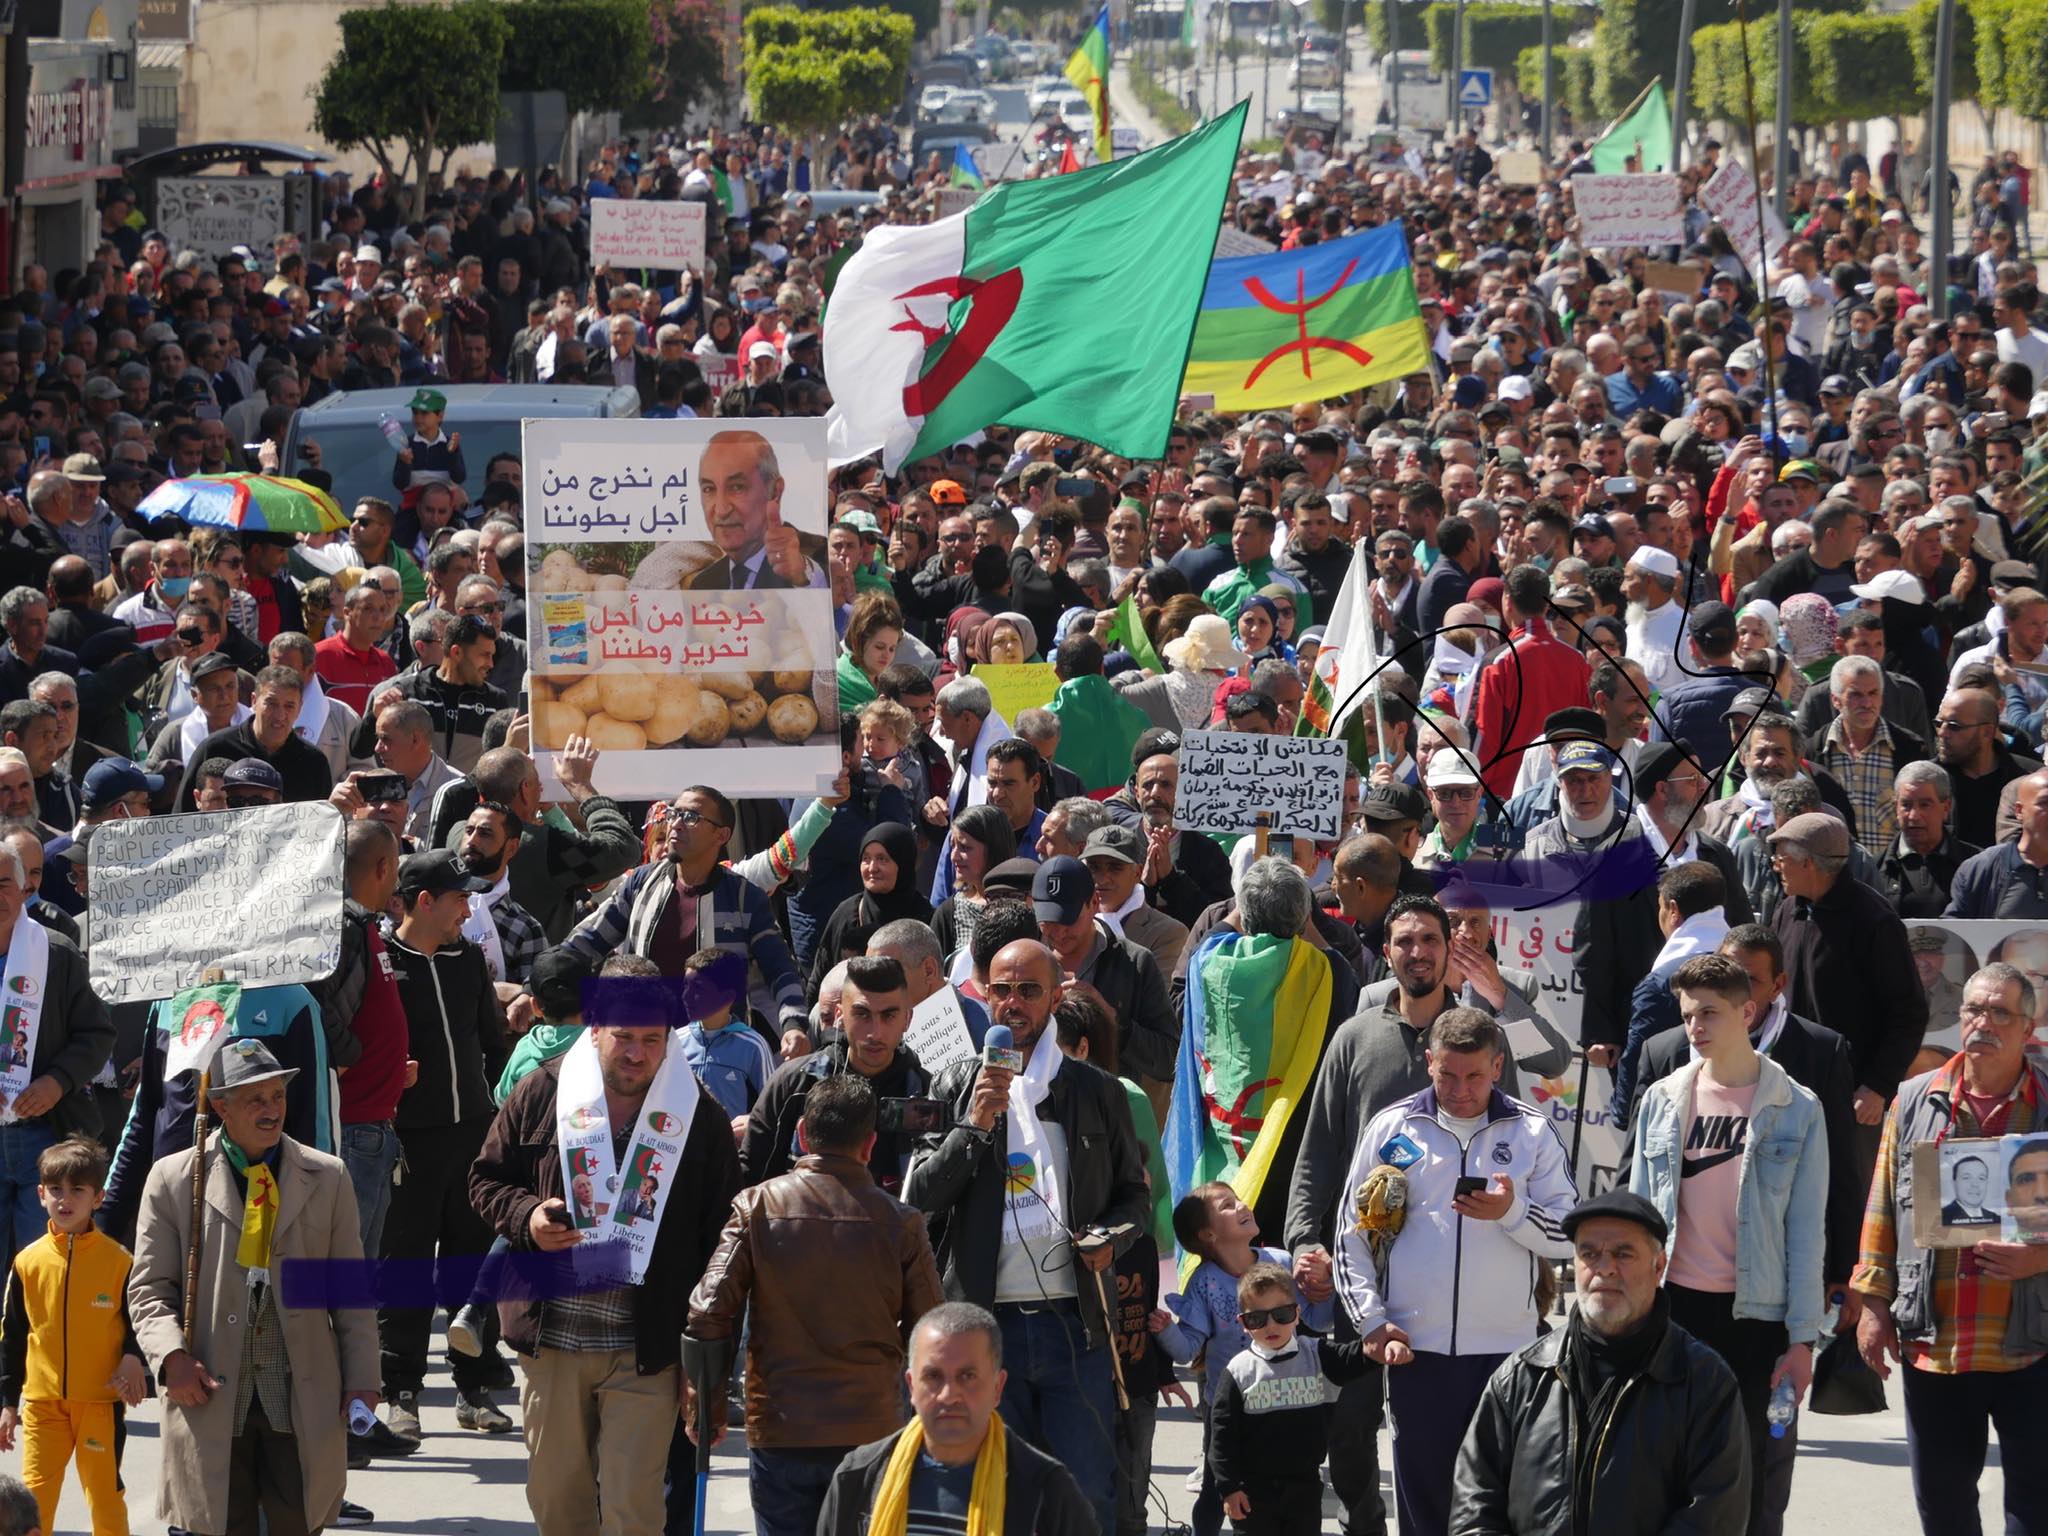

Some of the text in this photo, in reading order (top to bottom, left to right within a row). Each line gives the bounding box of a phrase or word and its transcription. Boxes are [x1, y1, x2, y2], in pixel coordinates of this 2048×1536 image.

[542, 466, 688, 501] لم نخرج من
[543, 493, 688, 534] أجل بطوننا
[589, 594, 638, 635] أجل
[647, 604, 684, 631] من
[690, 602, 765, 632] خرجنا
[601, 635, 749, 666] تحرير وطننا
[1312, 765, 1339, 782] مع
[193, 817, 214, 833] UN
[286, 806, 320, 823] AUX
[1207, 812, 1227, 827] 60
[1320, 815, 1337, 837] لا
[97, 839, 173, 862] PEUPLES
[154, 862, 165, 876] A
[171, 857, 187, 876] LA
[195, 848, 260, 874] MAISON
[90, 881, 135, 902] SANS
[143, 873, 206, 897] CRAINTE
[213, 870, 250, 888] POUR
[93, 902, 127, 921] UNE
[136, 891, 222, 918] PUISSANCE
[93, 895, 313, 943] SUR CE GOUVERNEMENT
[193, 929, 209, 946] ET
[1519, 916, 1544, 968] في
[104, 954, 312, 996] VIVE LE HIRAK
[921, 1015, 941, 1033] sous
[944, 1006, 953, 1016] la
[922, 1036, 964, 1067] sociale et
[575, 1133, 606, 1147] BOUDIAF
[657, 1140, 678, 1154] AHMED
[1687, 1116, 1748, 1150] NIKE
[613, 1225, 645, 1242] Libérez
